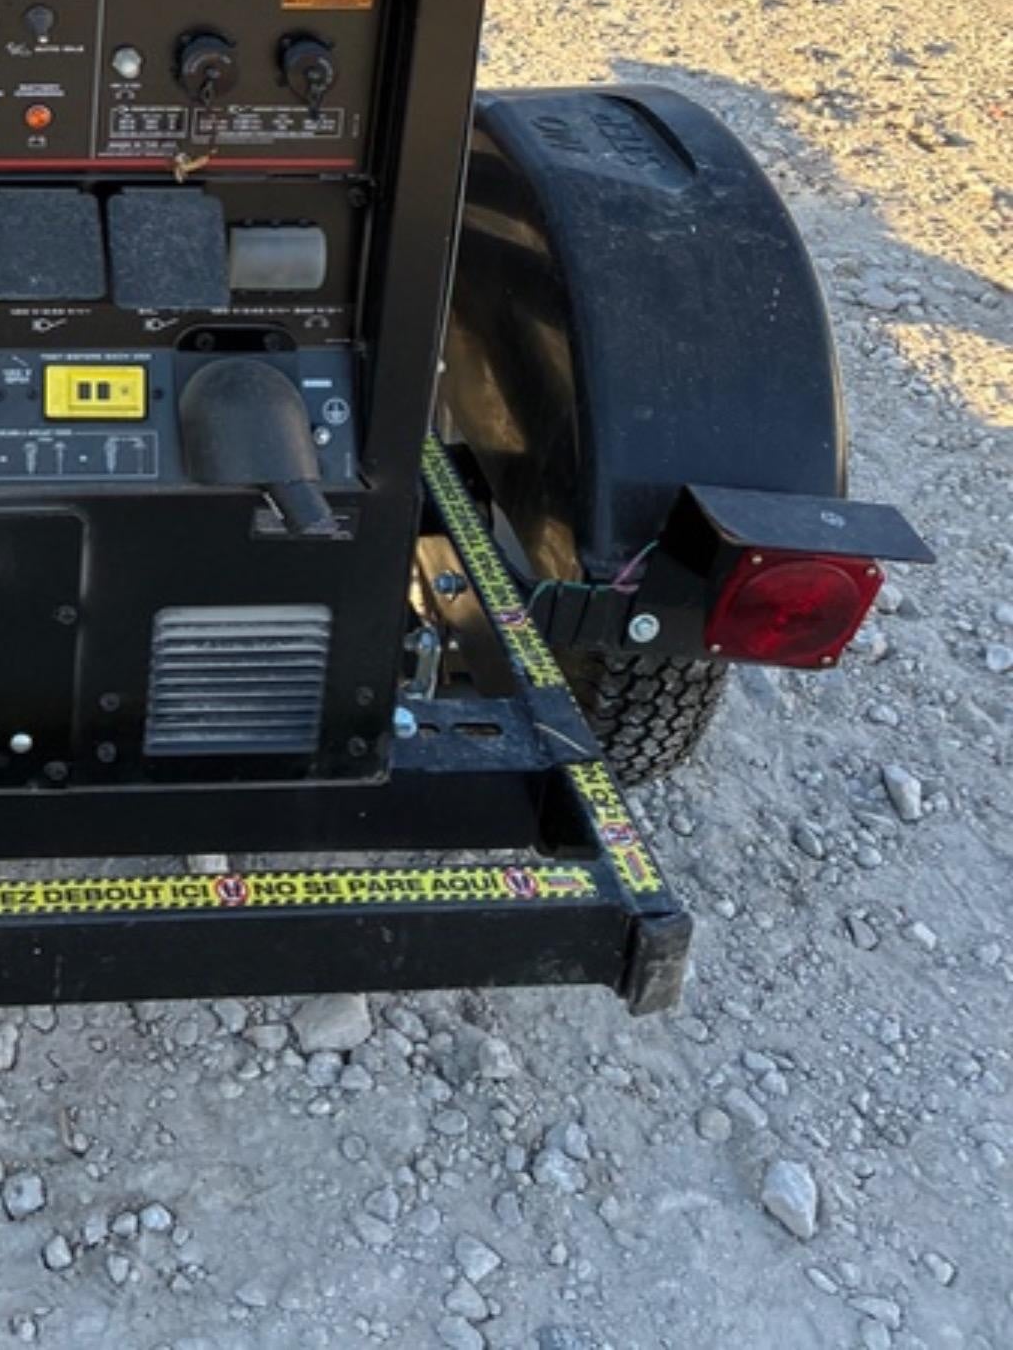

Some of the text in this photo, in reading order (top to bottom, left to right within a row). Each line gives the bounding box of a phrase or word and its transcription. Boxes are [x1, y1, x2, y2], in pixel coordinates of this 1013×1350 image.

[44, 885, 165, 903] DEBOUT
[171, 884, 210, 898] ICI
[253, 881, 297, 895] NO
[304, 880, 341, 895] SE
[346, 878, 425, 893] PARE
